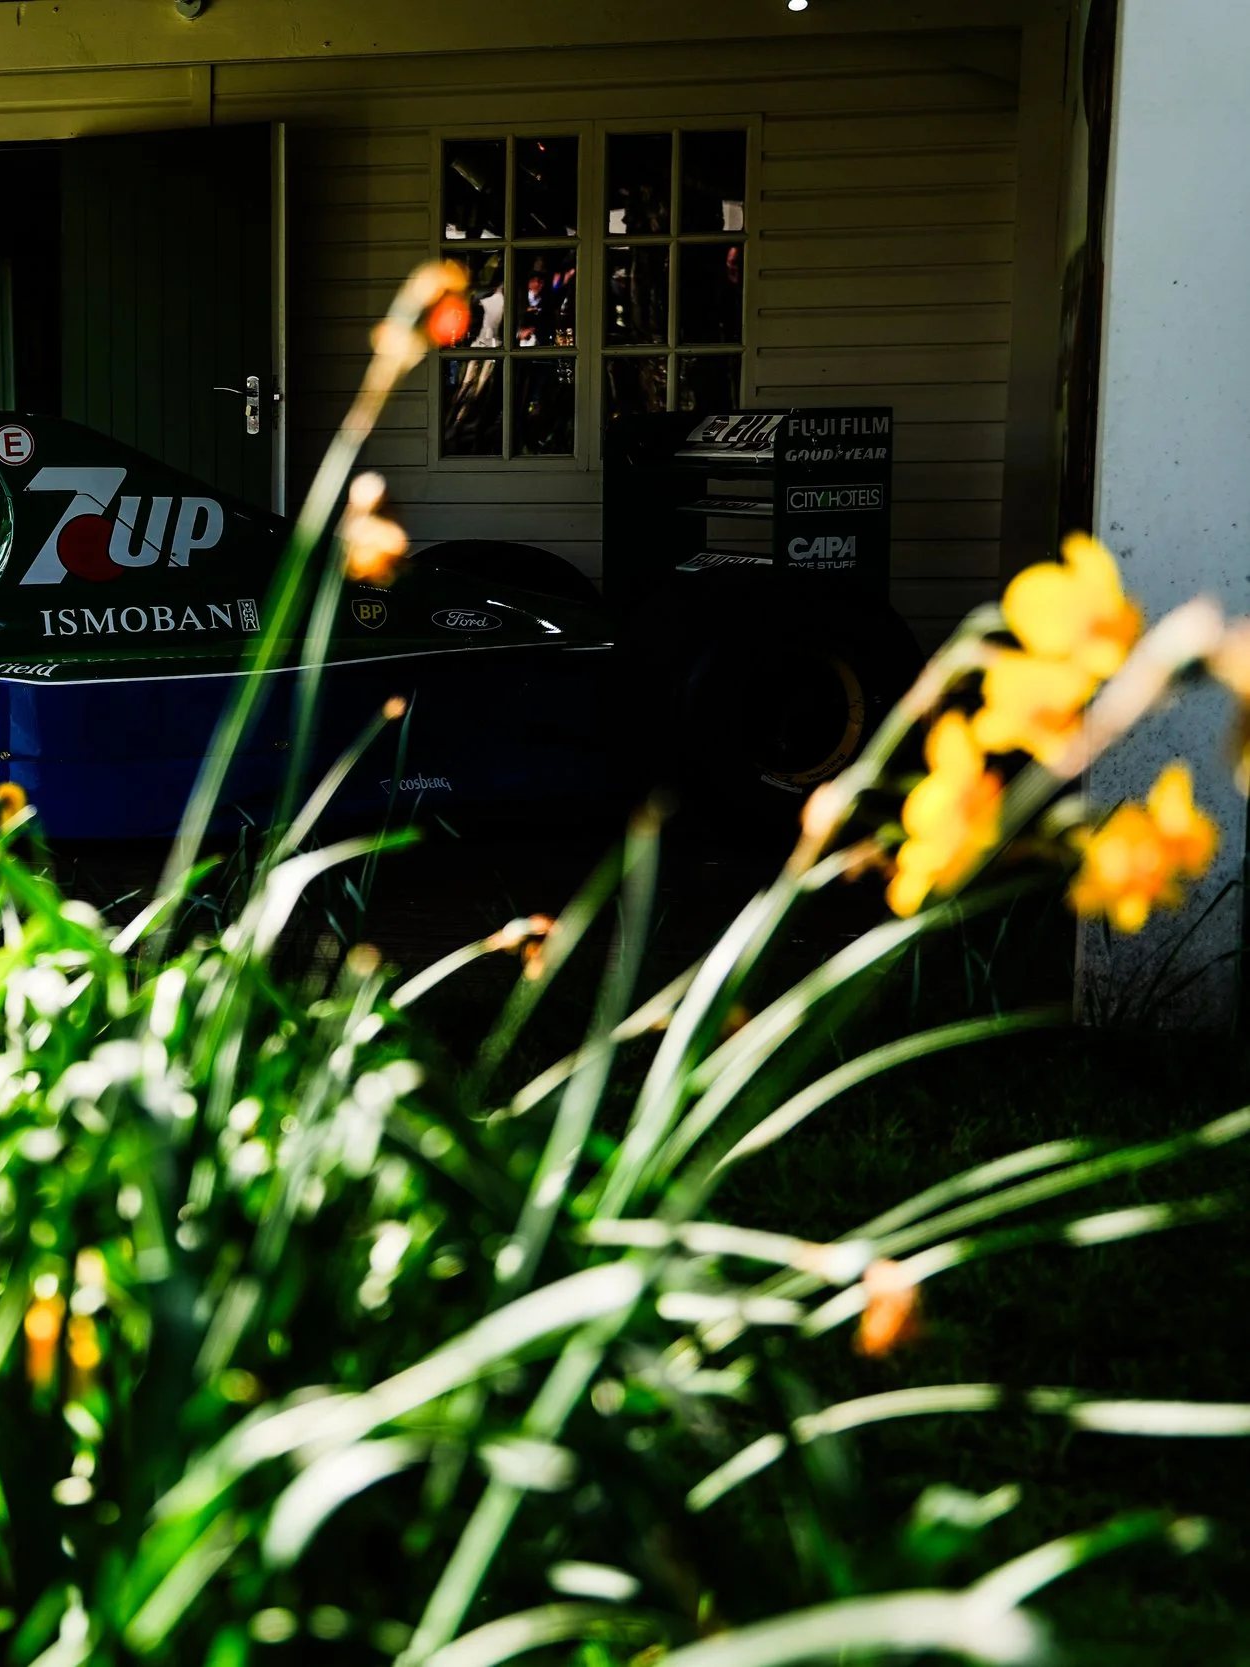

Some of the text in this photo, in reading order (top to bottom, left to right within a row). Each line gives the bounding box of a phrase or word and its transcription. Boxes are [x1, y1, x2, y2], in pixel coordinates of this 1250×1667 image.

[4, 432, 23, 456] E
[790, 488, 881, 509] CITY HOTELS
[19, 466, 225, 586] 7UP
[787, 535, 856, 560] CAPA
[40, 603, 234, 637] ISMOBAN
[358, 604, 383, 621] BP
[445, 611, 489, 628] Ford
